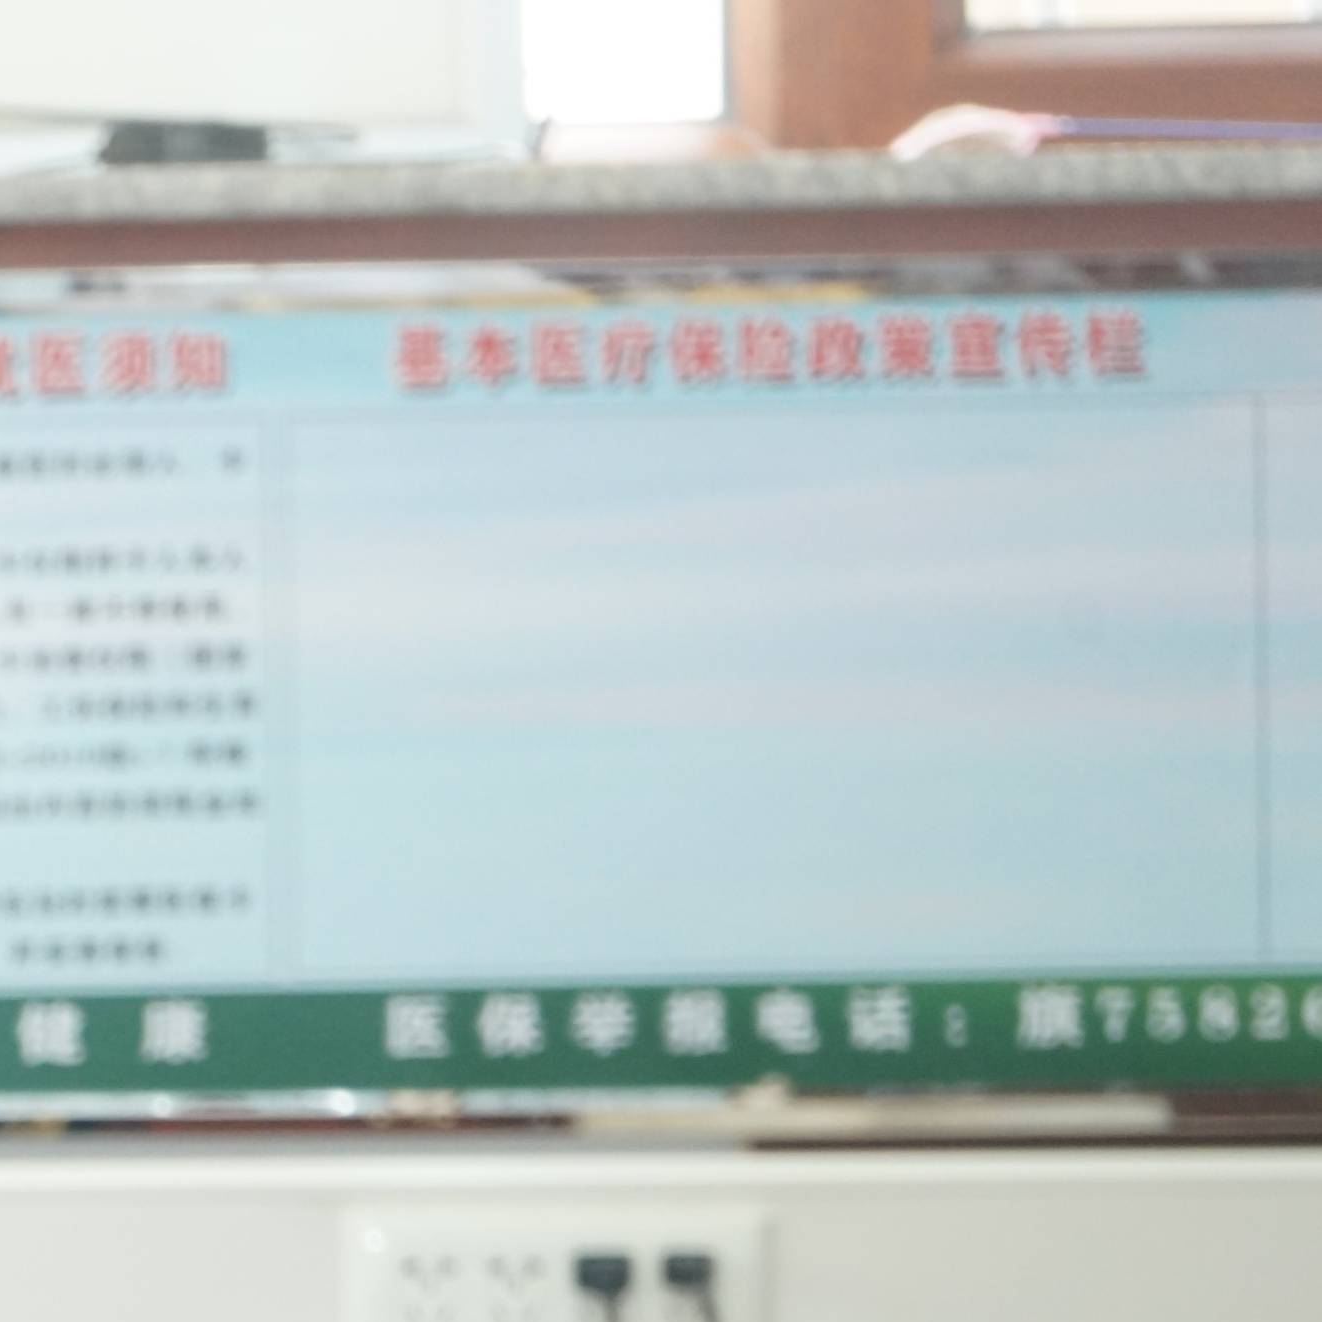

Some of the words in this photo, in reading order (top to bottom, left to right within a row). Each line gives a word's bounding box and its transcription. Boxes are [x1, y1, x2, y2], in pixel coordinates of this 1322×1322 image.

[394, 309, 1148, 388] 基本医疗保险政策宣传栏
